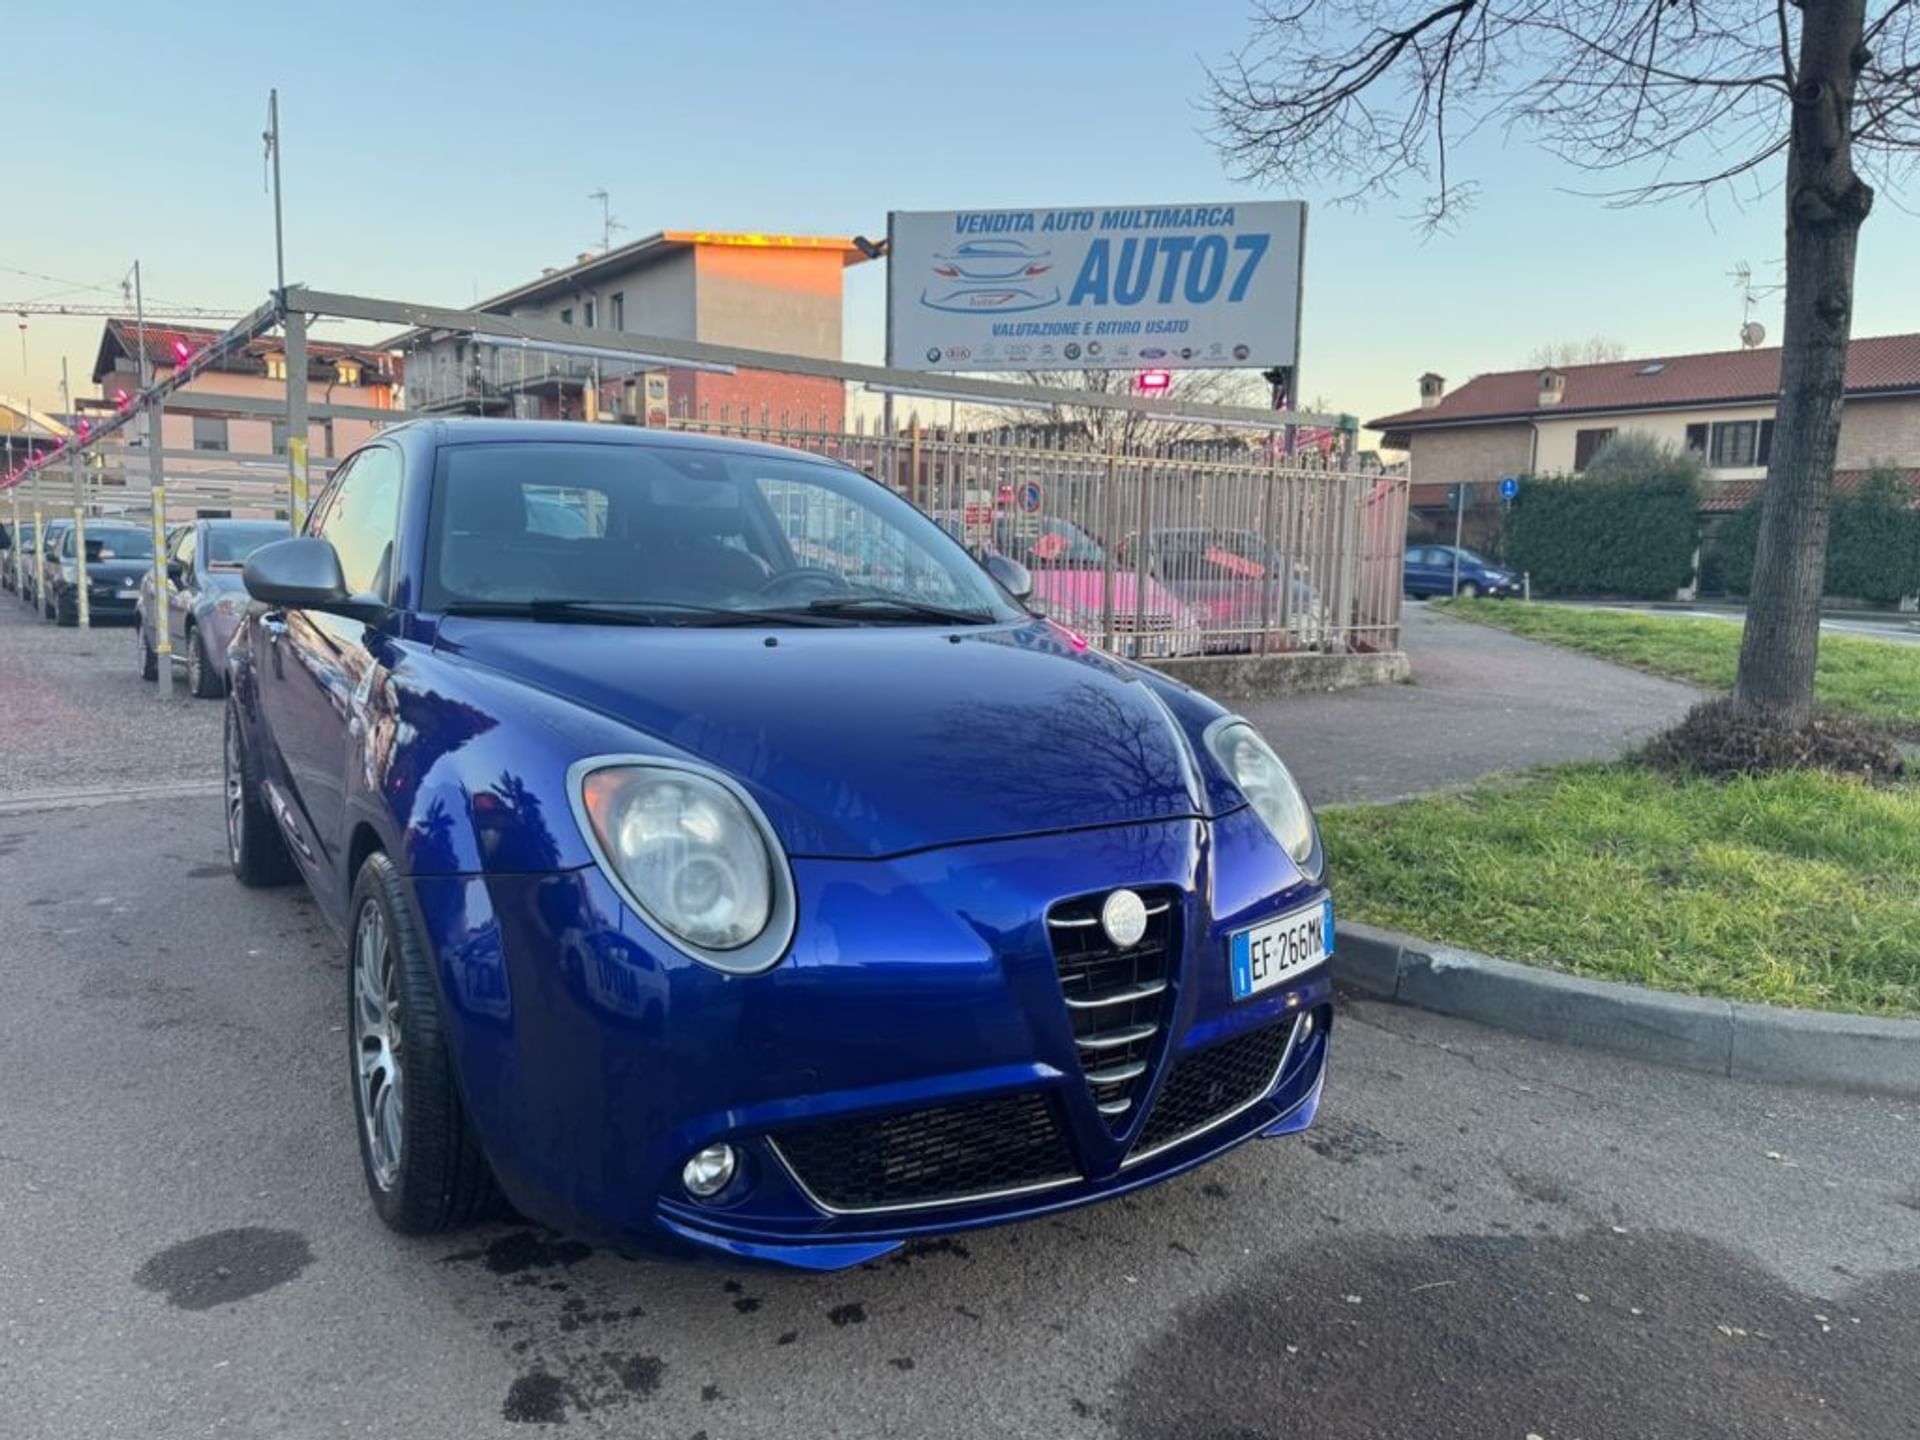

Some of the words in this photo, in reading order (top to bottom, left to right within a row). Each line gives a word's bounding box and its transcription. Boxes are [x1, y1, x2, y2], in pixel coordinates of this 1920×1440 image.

[955, 213, 1034, 233] VENDITA
[1042, 210, 1094, 231] AUTO
[1100, 207, 1235, 229] MULTIMARCA
[1067, 234, 1271, 306] AUTO7
[992, 321, 1079, 337] VALUTAZIONE
[1083, 321, 1094, 335] E
[1096, 320, 1141, 335] RITIRO
[1145, 319, 1190, 334] USATO
[1251, 936, 1272, 981] EF
